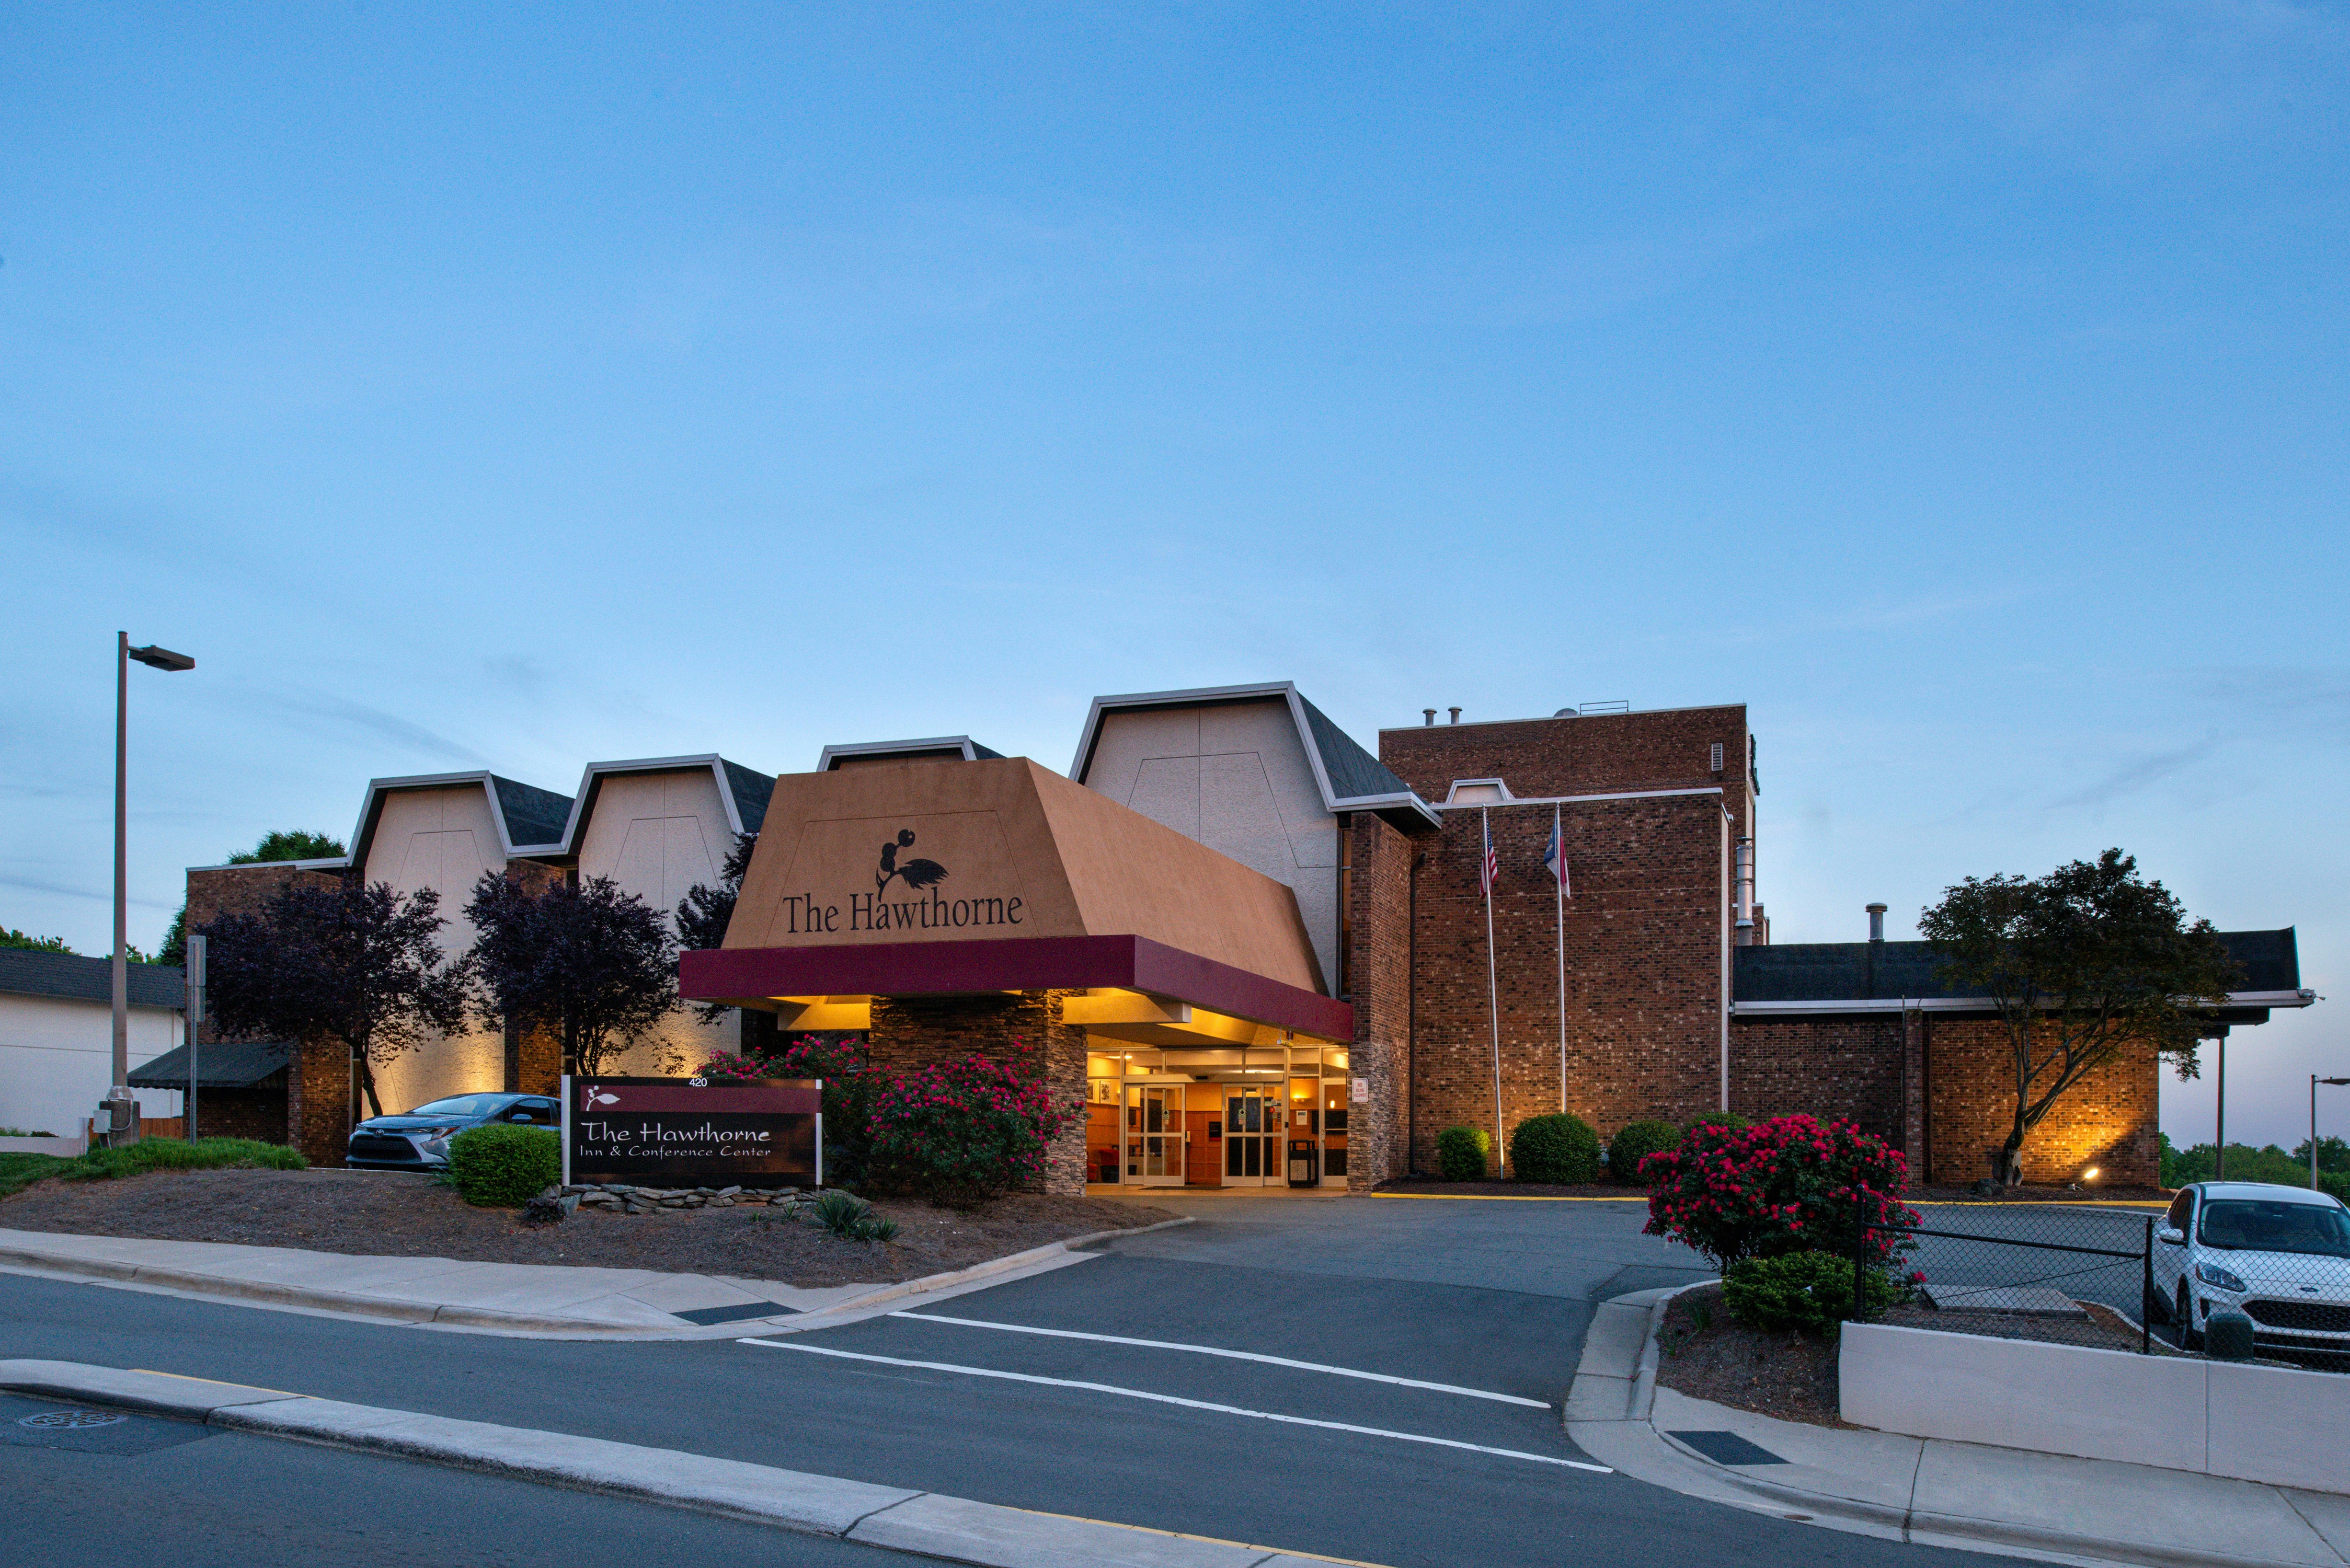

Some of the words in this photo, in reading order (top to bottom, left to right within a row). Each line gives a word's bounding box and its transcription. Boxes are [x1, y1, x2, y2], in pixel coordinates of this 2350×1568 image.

[783, 892, 839, 933] The
[850, 886, 1023, 930] Hawthorne
[689, 1078, 707, 1087] 420
[581, 1122, 631, 1142] The
[640, 1122, 771, 1142] Hawthorne
[581, 1145, 602, 1156] Inn
[610, 1145, 621, 1156] &
[628, 1145, 713, 1159] Conference
[720, 1145, 771, 1156] Center
